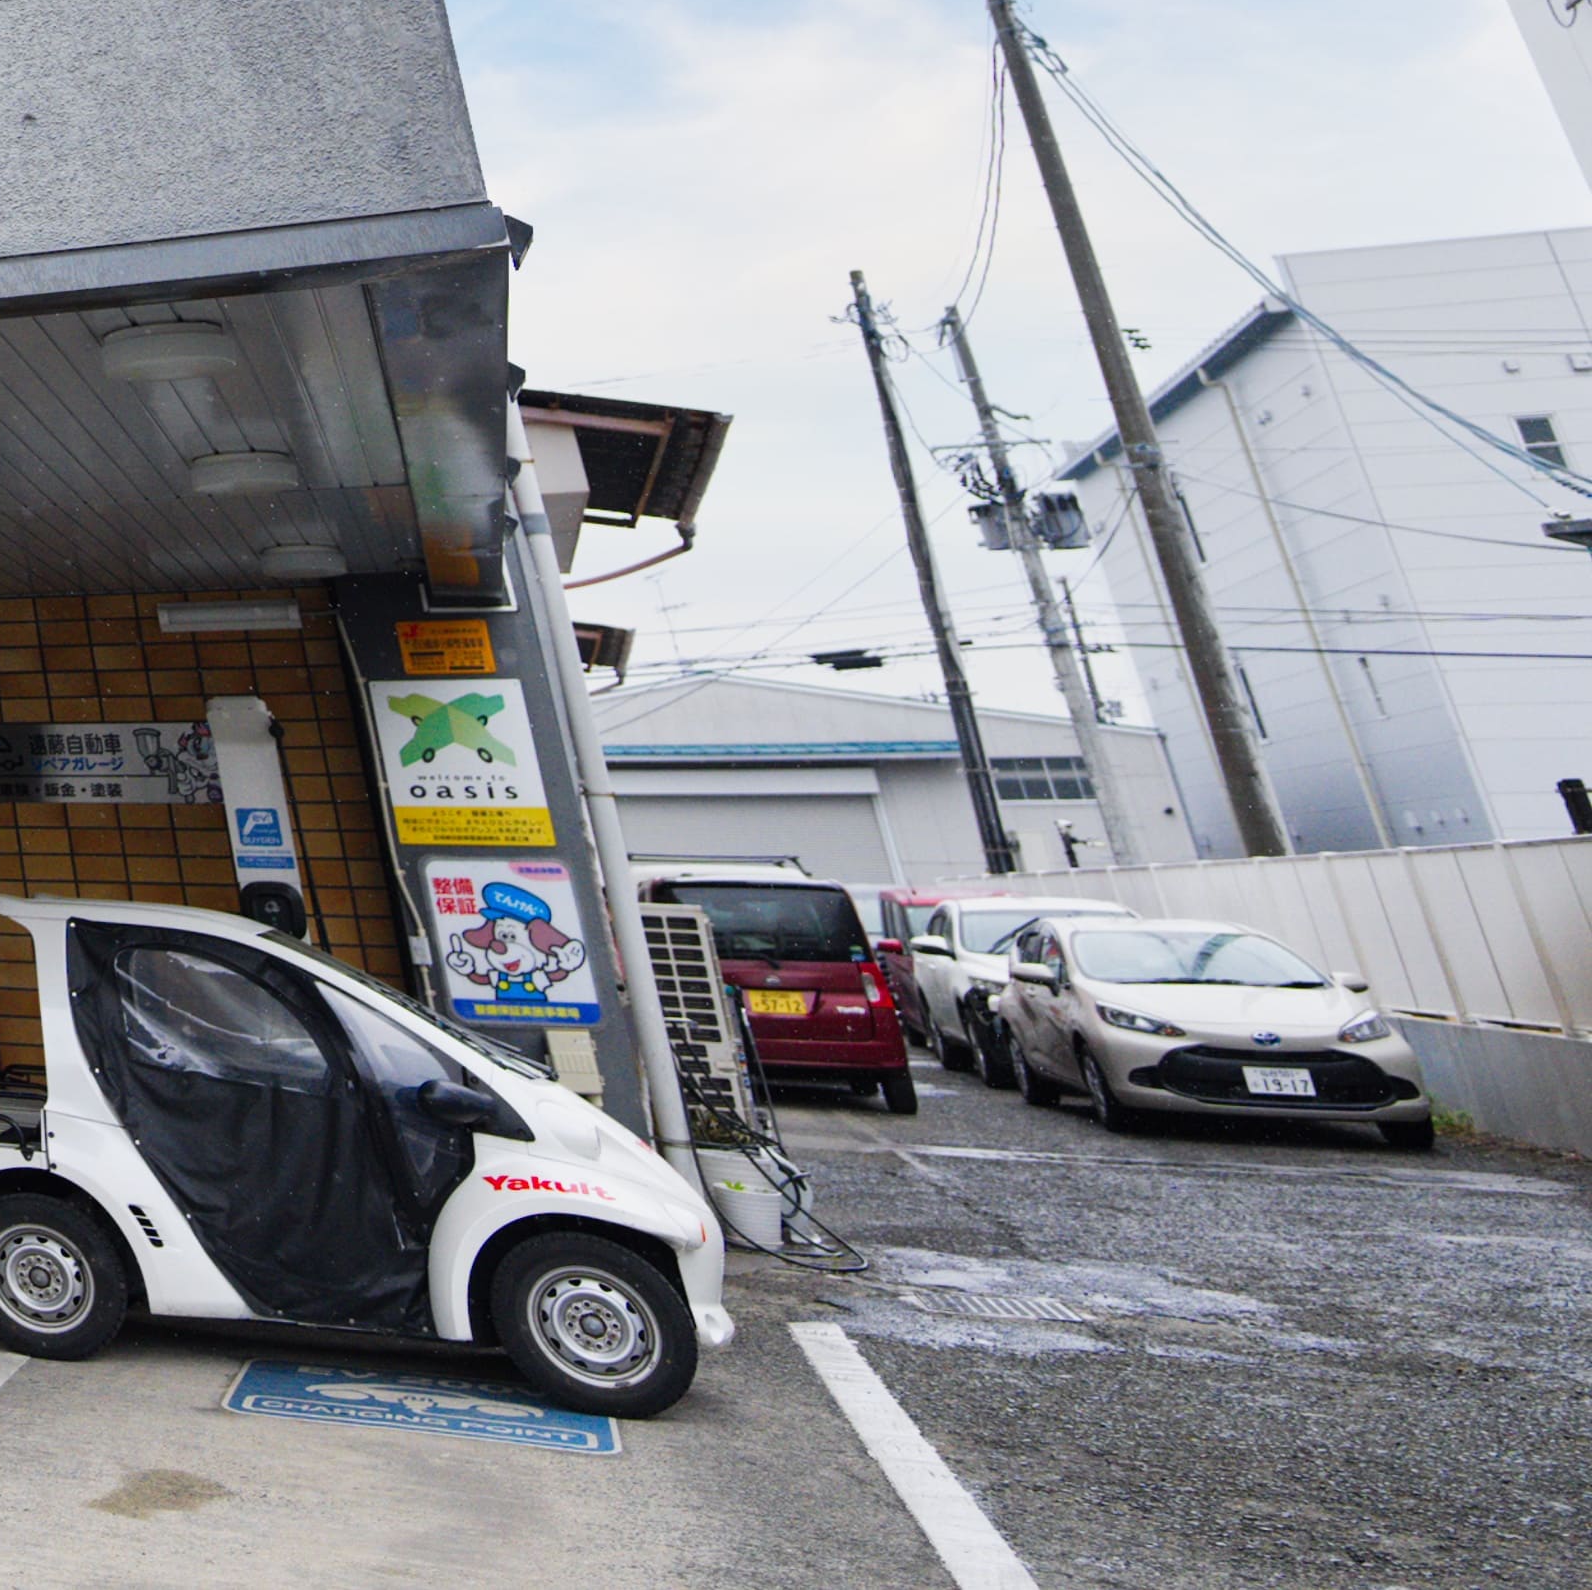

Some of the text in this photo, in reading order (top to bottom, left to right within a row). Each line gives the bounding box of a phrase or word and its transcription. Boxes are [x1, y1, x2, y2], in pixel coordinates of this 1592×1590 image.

[29, 733, 123, 755] 遠藤自動車
[31, 757, 124, 771] リペアガレージ
[410, 782, 518, 799] oasis
[432, 878, 474, 895] 整備
[436, 898, 479, 915] 保証
[1263, 1078, 1309, 1093] 19-17
[482, 1175, 616, 1201] Yakult
[260, 1399, 579, 1443] CHARGING POINT
